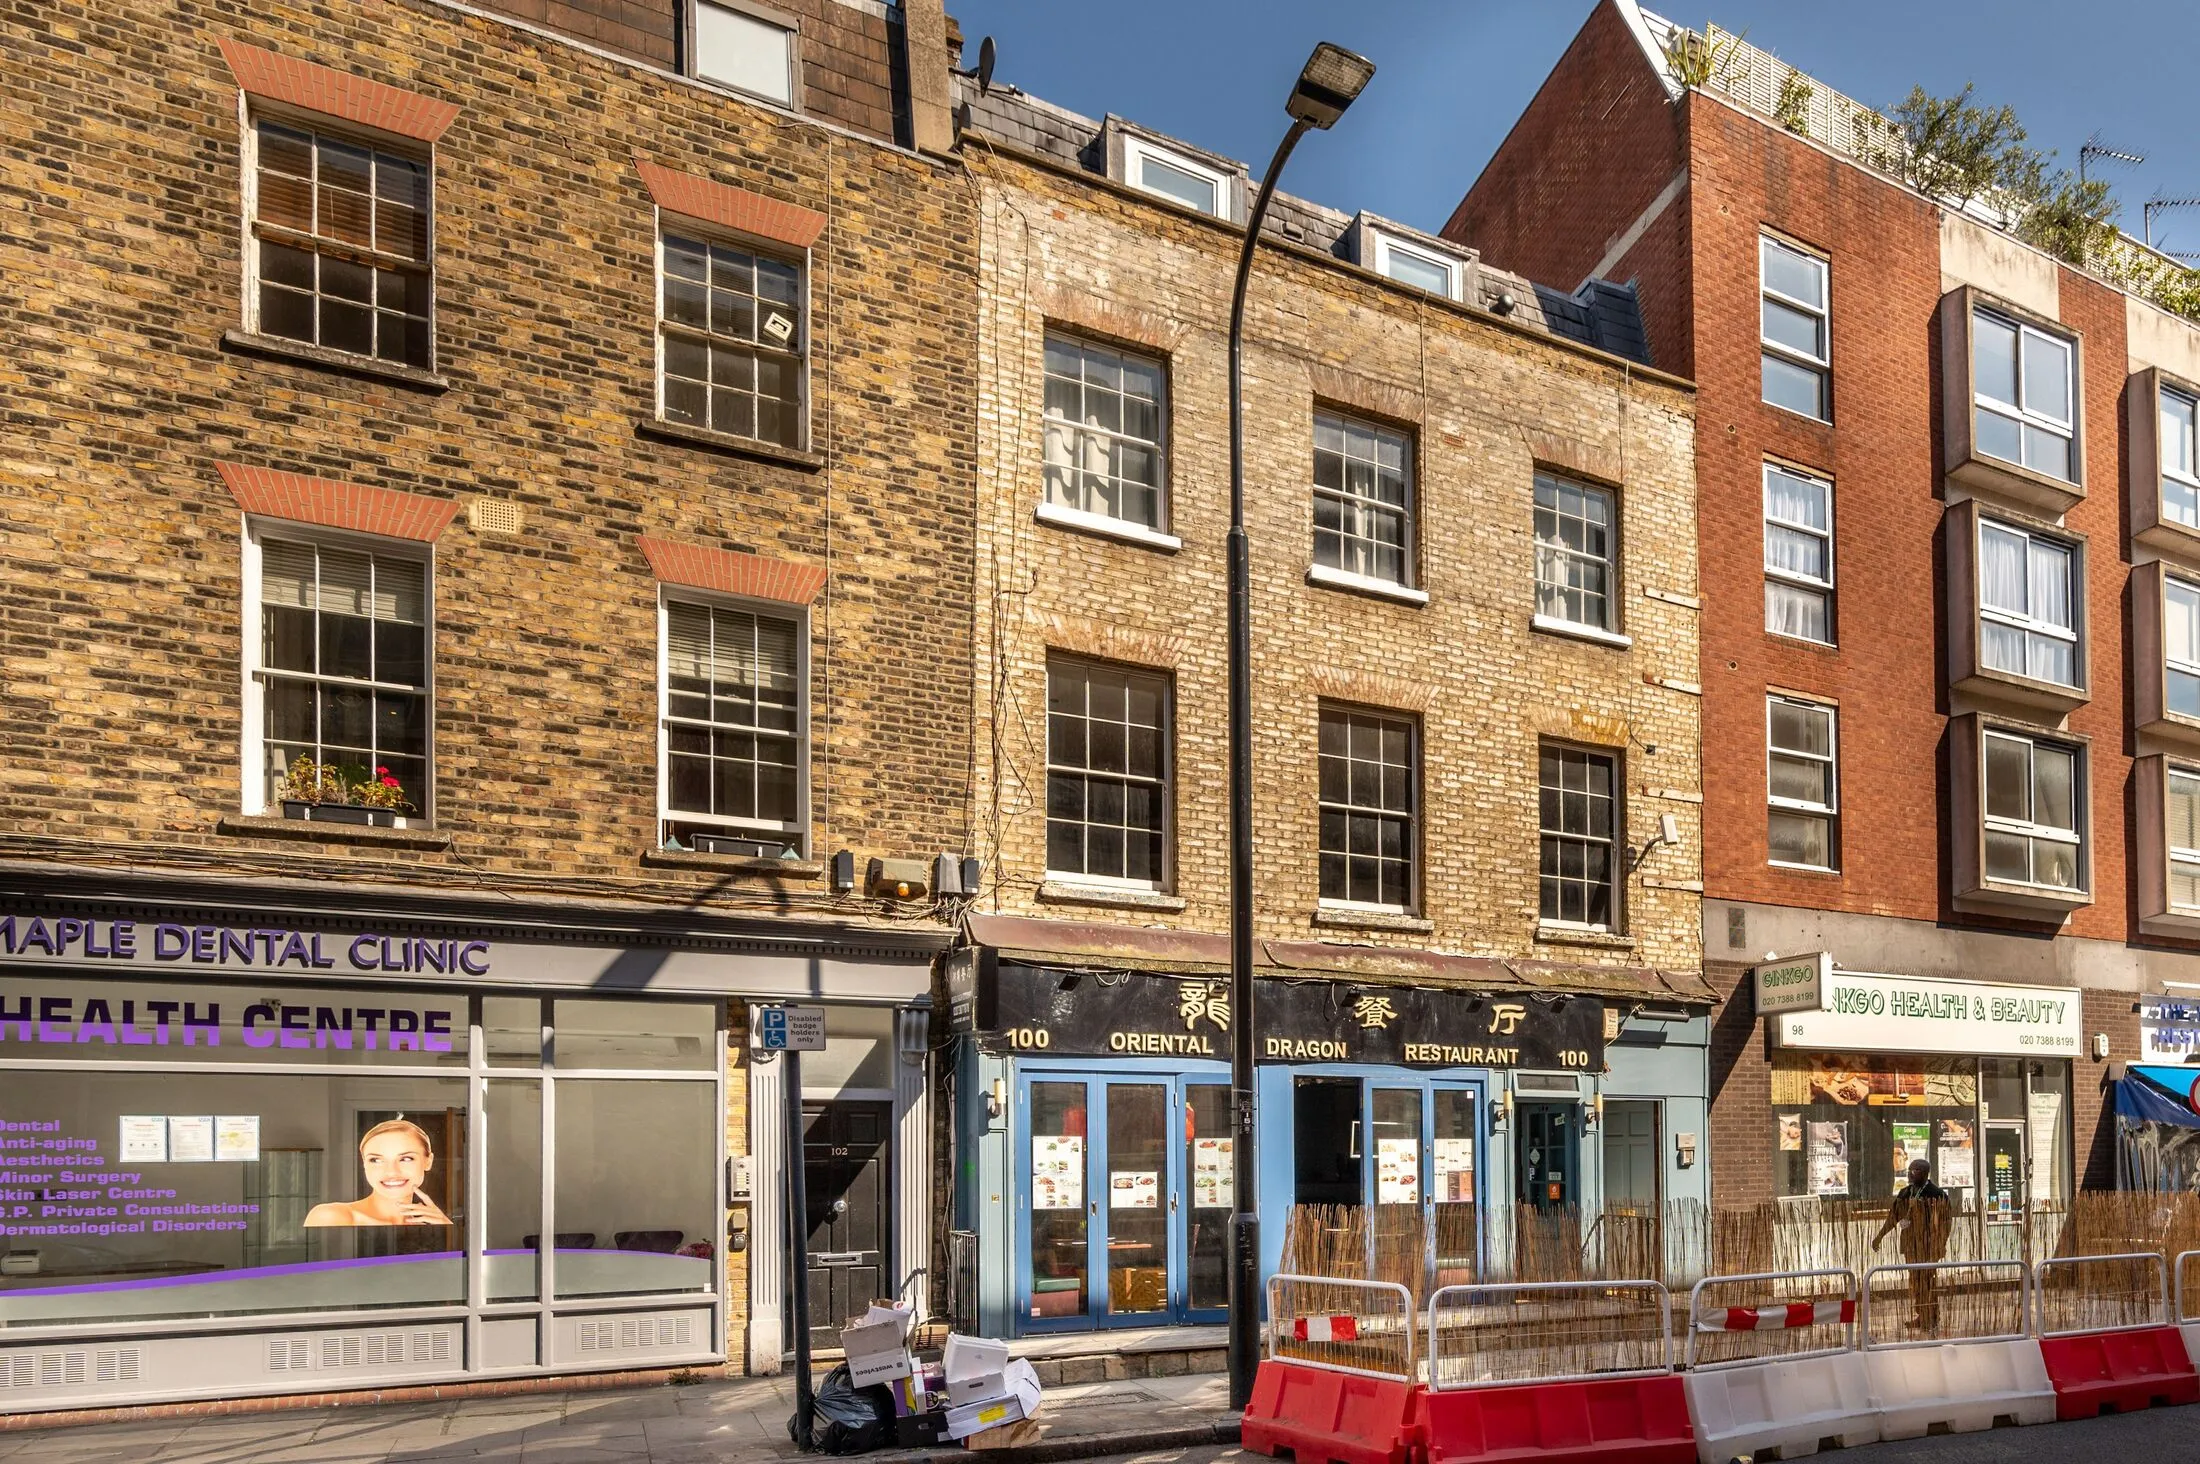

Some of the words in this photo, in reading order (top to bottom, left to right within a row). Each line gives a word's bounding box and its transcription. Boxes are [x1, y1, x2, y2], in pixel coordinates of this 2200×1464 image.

[156, 922, 335, 964] DENTAL
[352, 933, 490, 972] CLINIC
[1762, 964, 1814, 988] GINKGO
[1762, 997, 1776, 1006] 020
[1777, 994, 1795, 1004] 7388
[1796, 991, 1814, 1001] 8199
[1832, 987, 1885, 1015] NKGO
[1891, 991, 1967, 1019] HEALTH
[1973, 996, 1986, 1021] &
[1991, 998, 2066, 1024] BEAUTY
[0, 996, 220, 1047] HEALTH
[242, 1004, 452, 1051] CENTRE
[769, 1012, 783, 1027] P
[1791, 1025, 1804, 1036] 98
[1006, 1028, 1049, 1049] 100
[1110, 1032, 1214, 1054] ORIENTAL
[1266, 1038, 1347, 1059] DRAGON
[1404, 1044, 1519, 1065] RESTAURANT
[1559, 1050, 1589, 1067] 100
[2019, 1035, 2034, 1045] 020
[2036, 1035, 2054, 1046] 7388
[2056, 1037, 2075, 1047] 8199
[831, 1147, 848, 1156] 102
[0, 1171, 53, 1183] Minor
[60, 1171, 142, 1185] Surgery
[43, 1188, 102, 1200] Laser
[108, 1187, 177, 1199] Centre
[42, 1205, 118, 1217] Private
[125, 1202, 260, 1216] Consultations
[152, 1219, 248, 1232] Disorders
